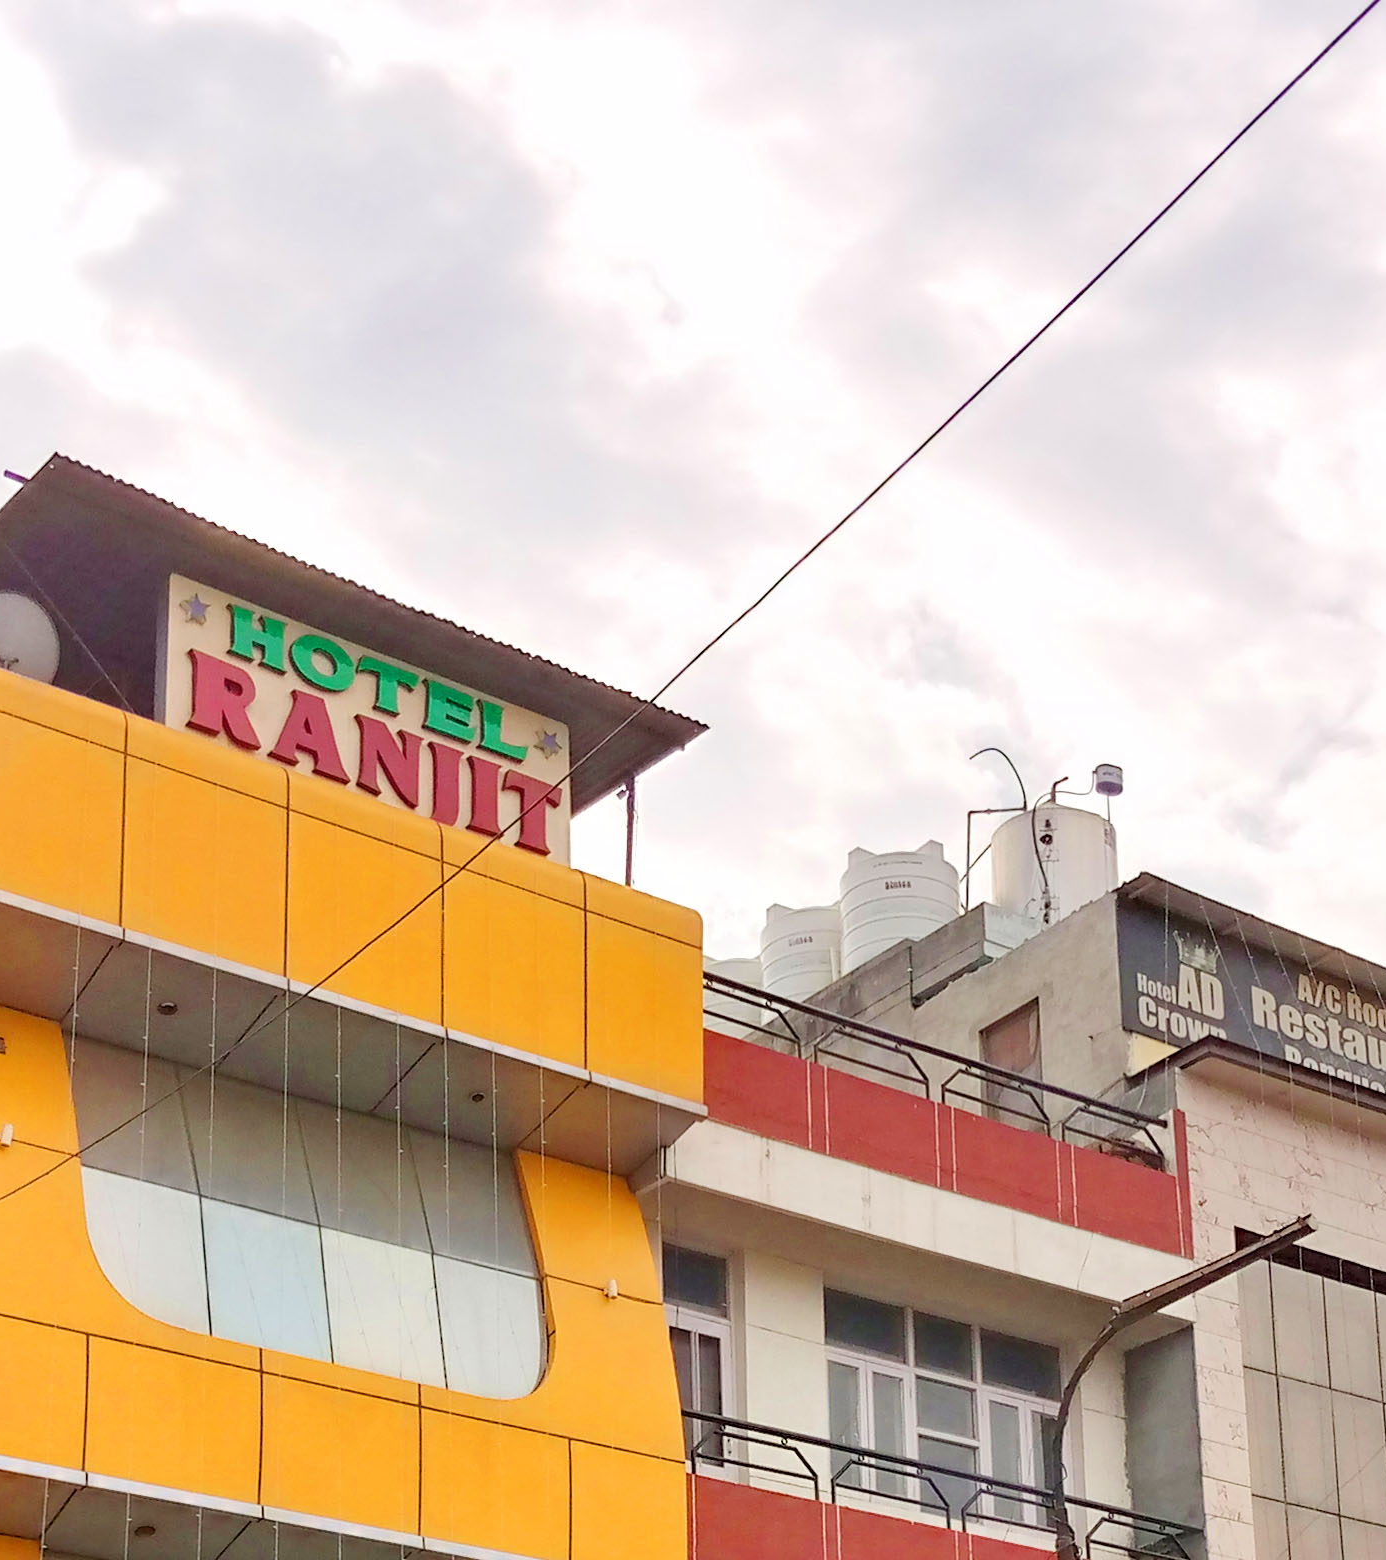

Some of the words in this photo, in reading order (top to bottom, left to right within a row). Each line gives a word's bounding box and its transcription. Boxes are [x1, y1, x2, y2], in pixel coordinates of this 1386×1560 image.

[227, 602, 529, 764] HOTEL
[186, 647, 564, 857] RANJIT
[1136, 971, 1177, 1005] Hotel
[1178, 963, 1225, 1021] AD
[1298, 973, 1342, 1016] A/C
